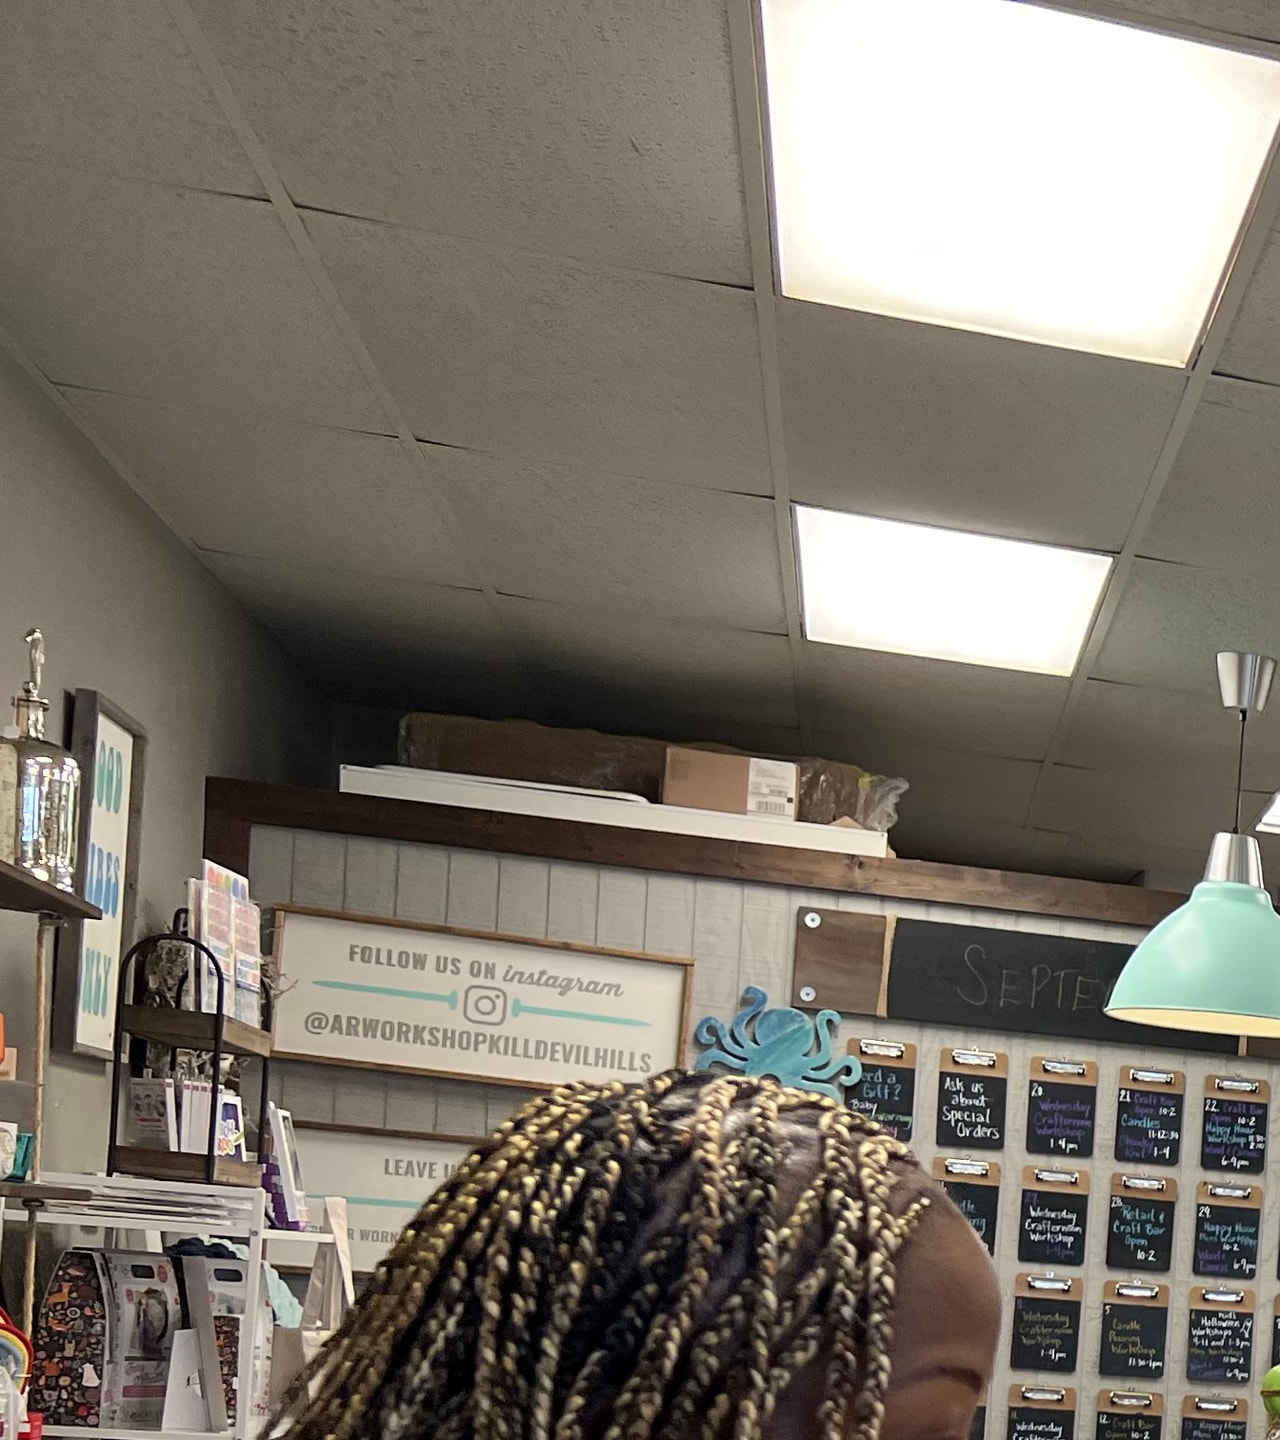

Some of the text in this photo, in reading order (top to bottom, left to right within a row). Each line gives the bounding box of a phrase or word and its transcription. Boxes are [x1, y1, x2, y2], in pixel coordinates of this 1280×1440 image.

[349, 944, 624, 997] FOLLOW US ON instagram
[956, 944, 1115, 1012] SEPTE
[304, 1011, 651, 1073] @ARWORKSHOPKILLDEVILHILLS
[944, 1077, 985, 1094] Ask us
[951, 1093, 988, 1108] about
[942, 1106, 991, 1127] Special
[1120, 1113, 1161, 1129] Candles
[956, 1122, 1000, 1140] Orders
[384, 1159, 460, 1179] LEAVE U
